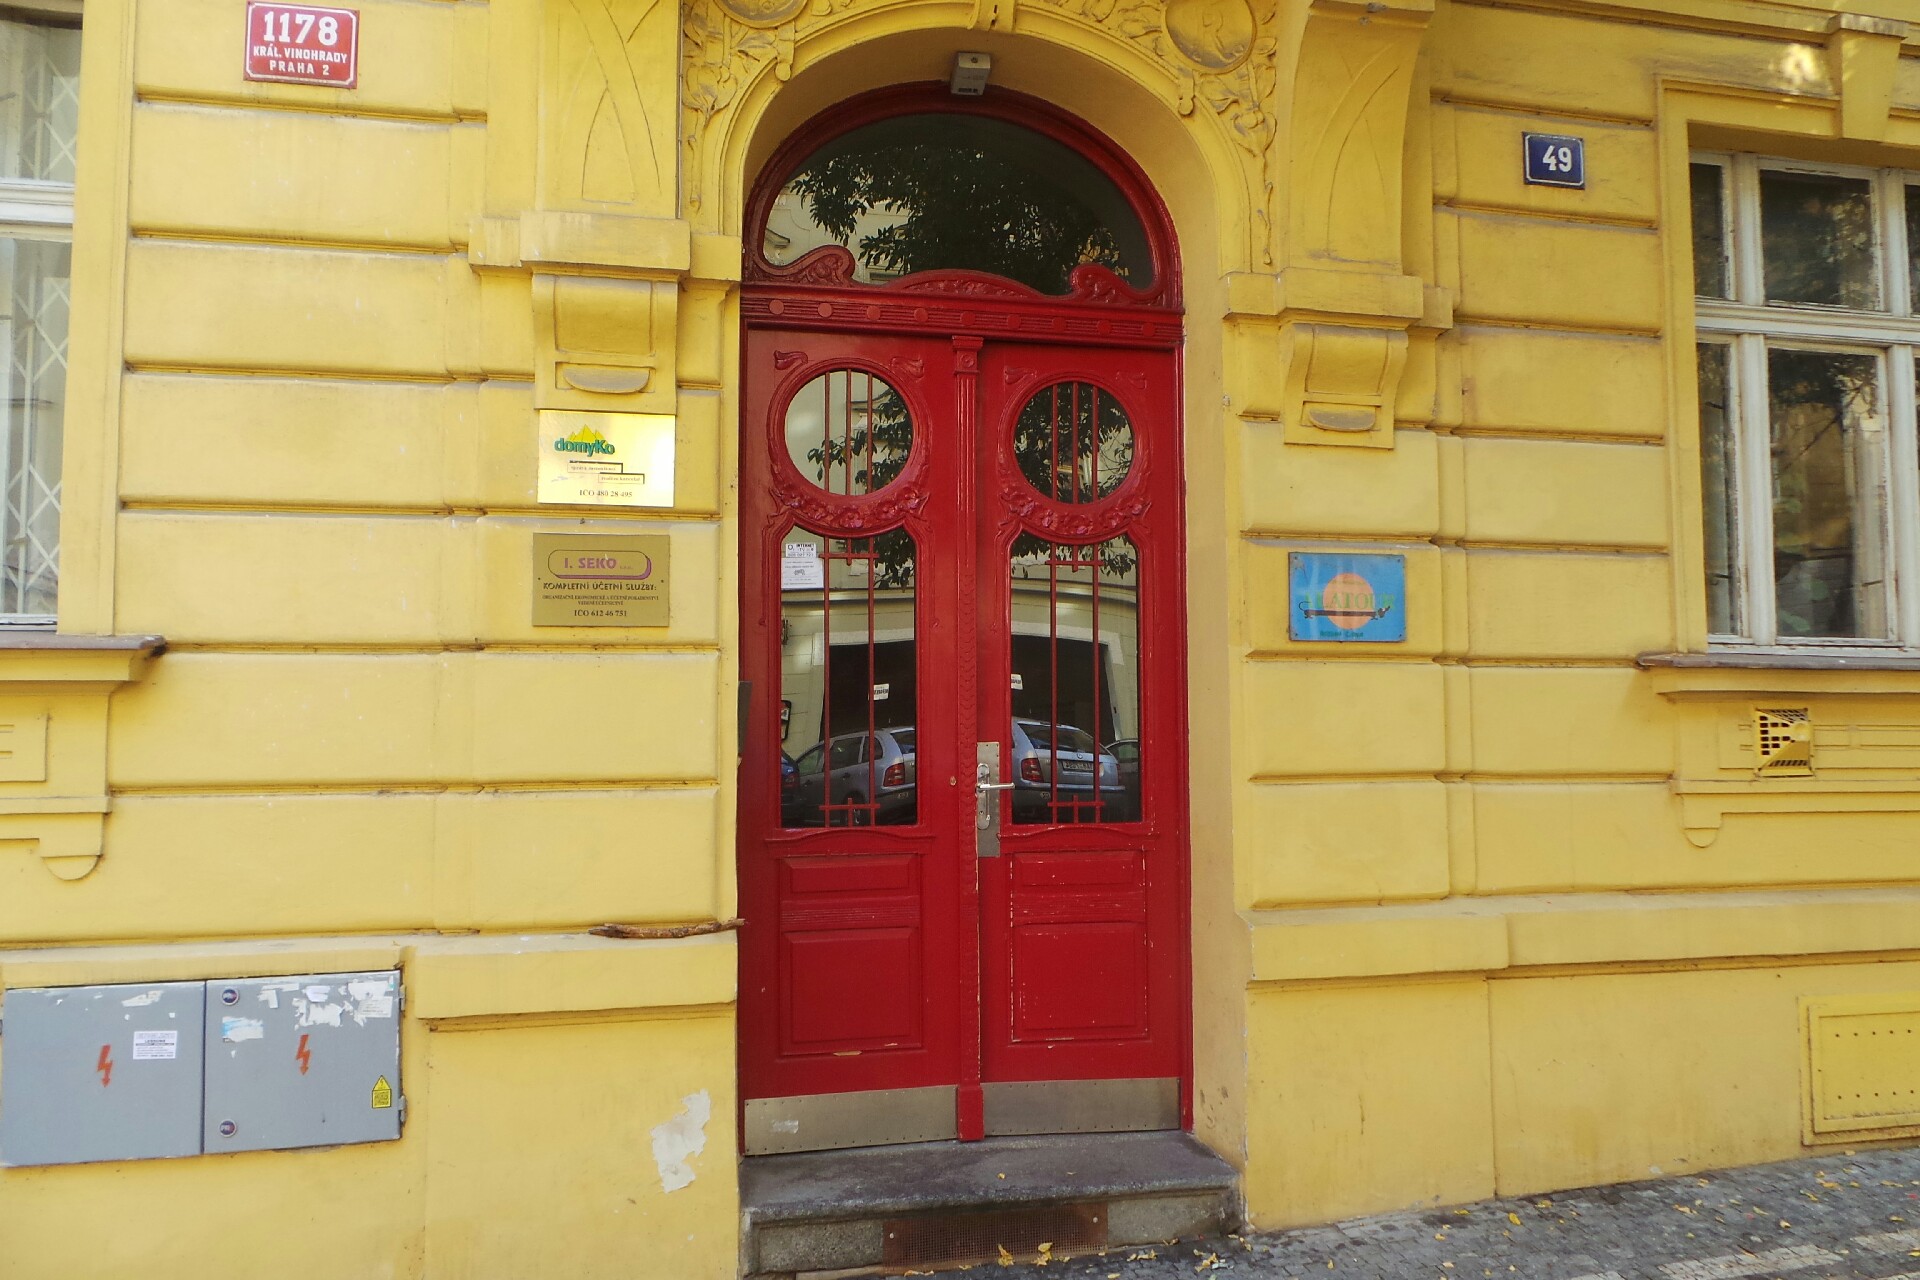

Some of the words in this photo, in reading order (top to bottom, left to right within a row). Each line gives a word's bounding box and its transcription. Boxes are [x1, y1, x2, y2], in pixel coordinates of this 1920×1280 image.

[263, 11, 338, 46] 1178
[253, 43, 282, 58] KRÁL.
[284, 47, 348, 64] VINOHRADY
[269, 60, 315, 75] PRAHA
[322, 64, 330, 76] 2
[1542, 145, 1572, 173] 49
[578, 557, 617, 569] SEKO
[543, 581, 589, 590] KOMPLETNÍ
[592, 580, 623, 590] ÚČETNÍ
[625, 581, 657, 591] SLUŽBY:
[590, 609, 604, 617] 612
[605, 609, 614, 617] 46
